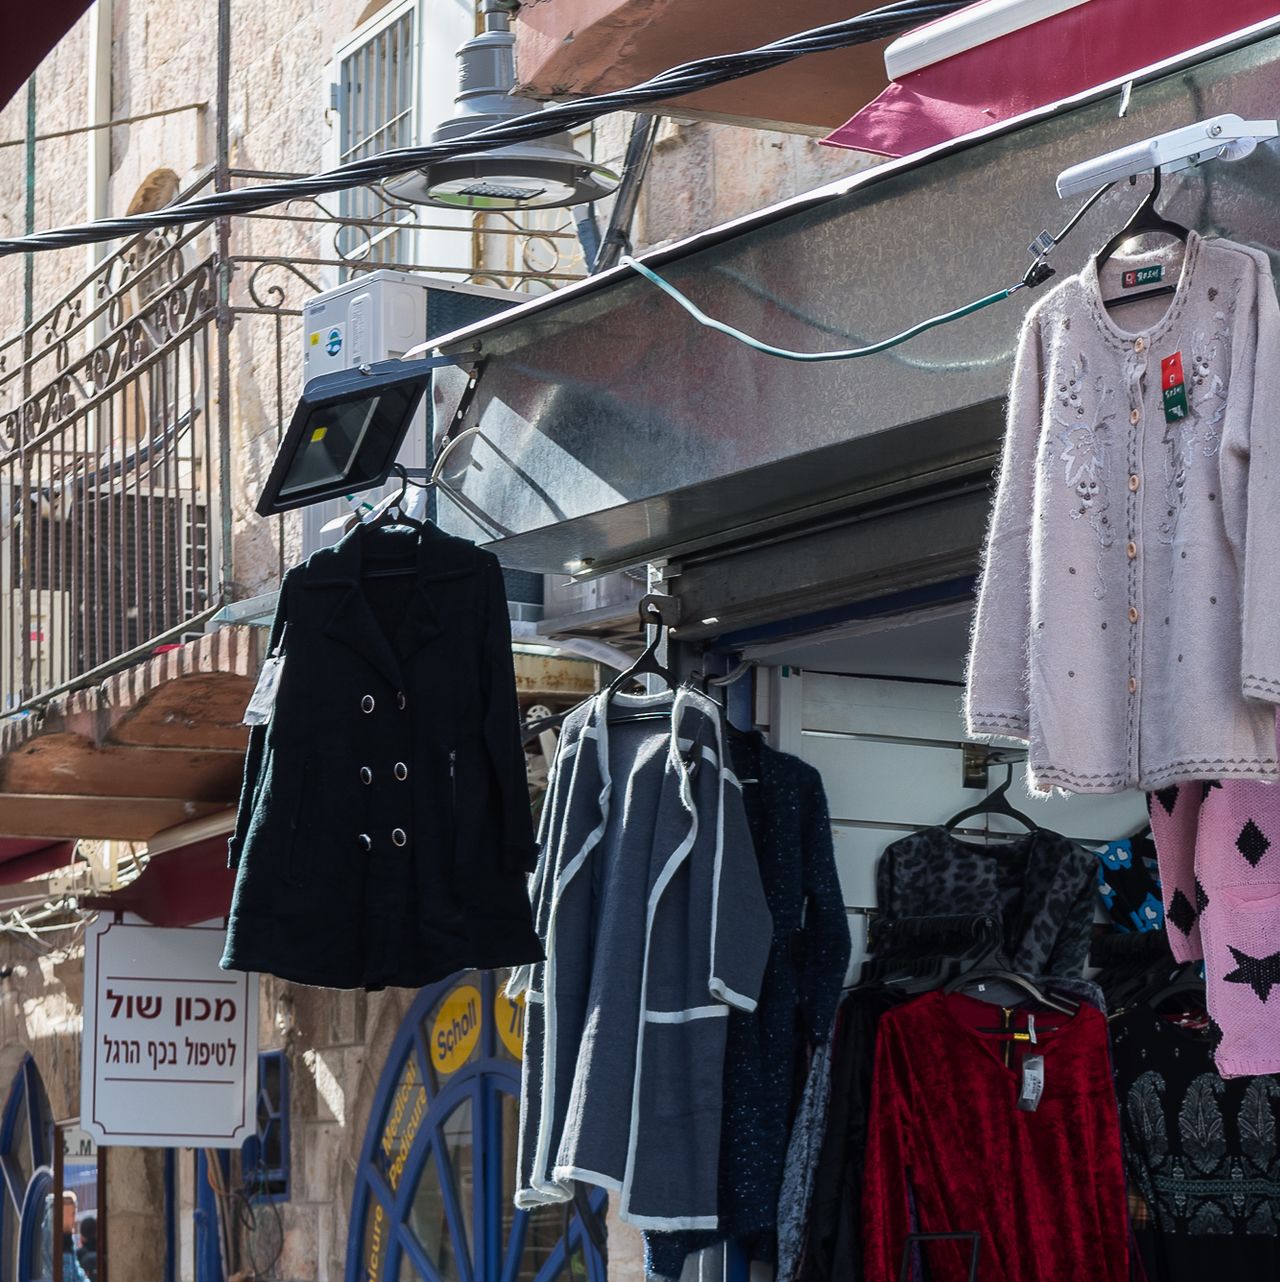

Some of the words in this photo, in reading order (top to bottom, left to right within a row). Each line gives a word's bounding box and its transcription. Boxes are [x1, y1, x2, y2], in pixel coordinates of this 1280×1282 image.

[106, 989, 163, 1019] שול
[175, 996, 237, 1027] מכון
[436, 998, 478, 1060] Scholl
[104, 1034, 140, 1064] הרגל
[148, 1039, 177, 1070] בכף
[185, 1037, 237, 1066] לטיפול
[382, 1059, 418, 1156] Medical
[389, 1086, 428, 1189] Pedicure
